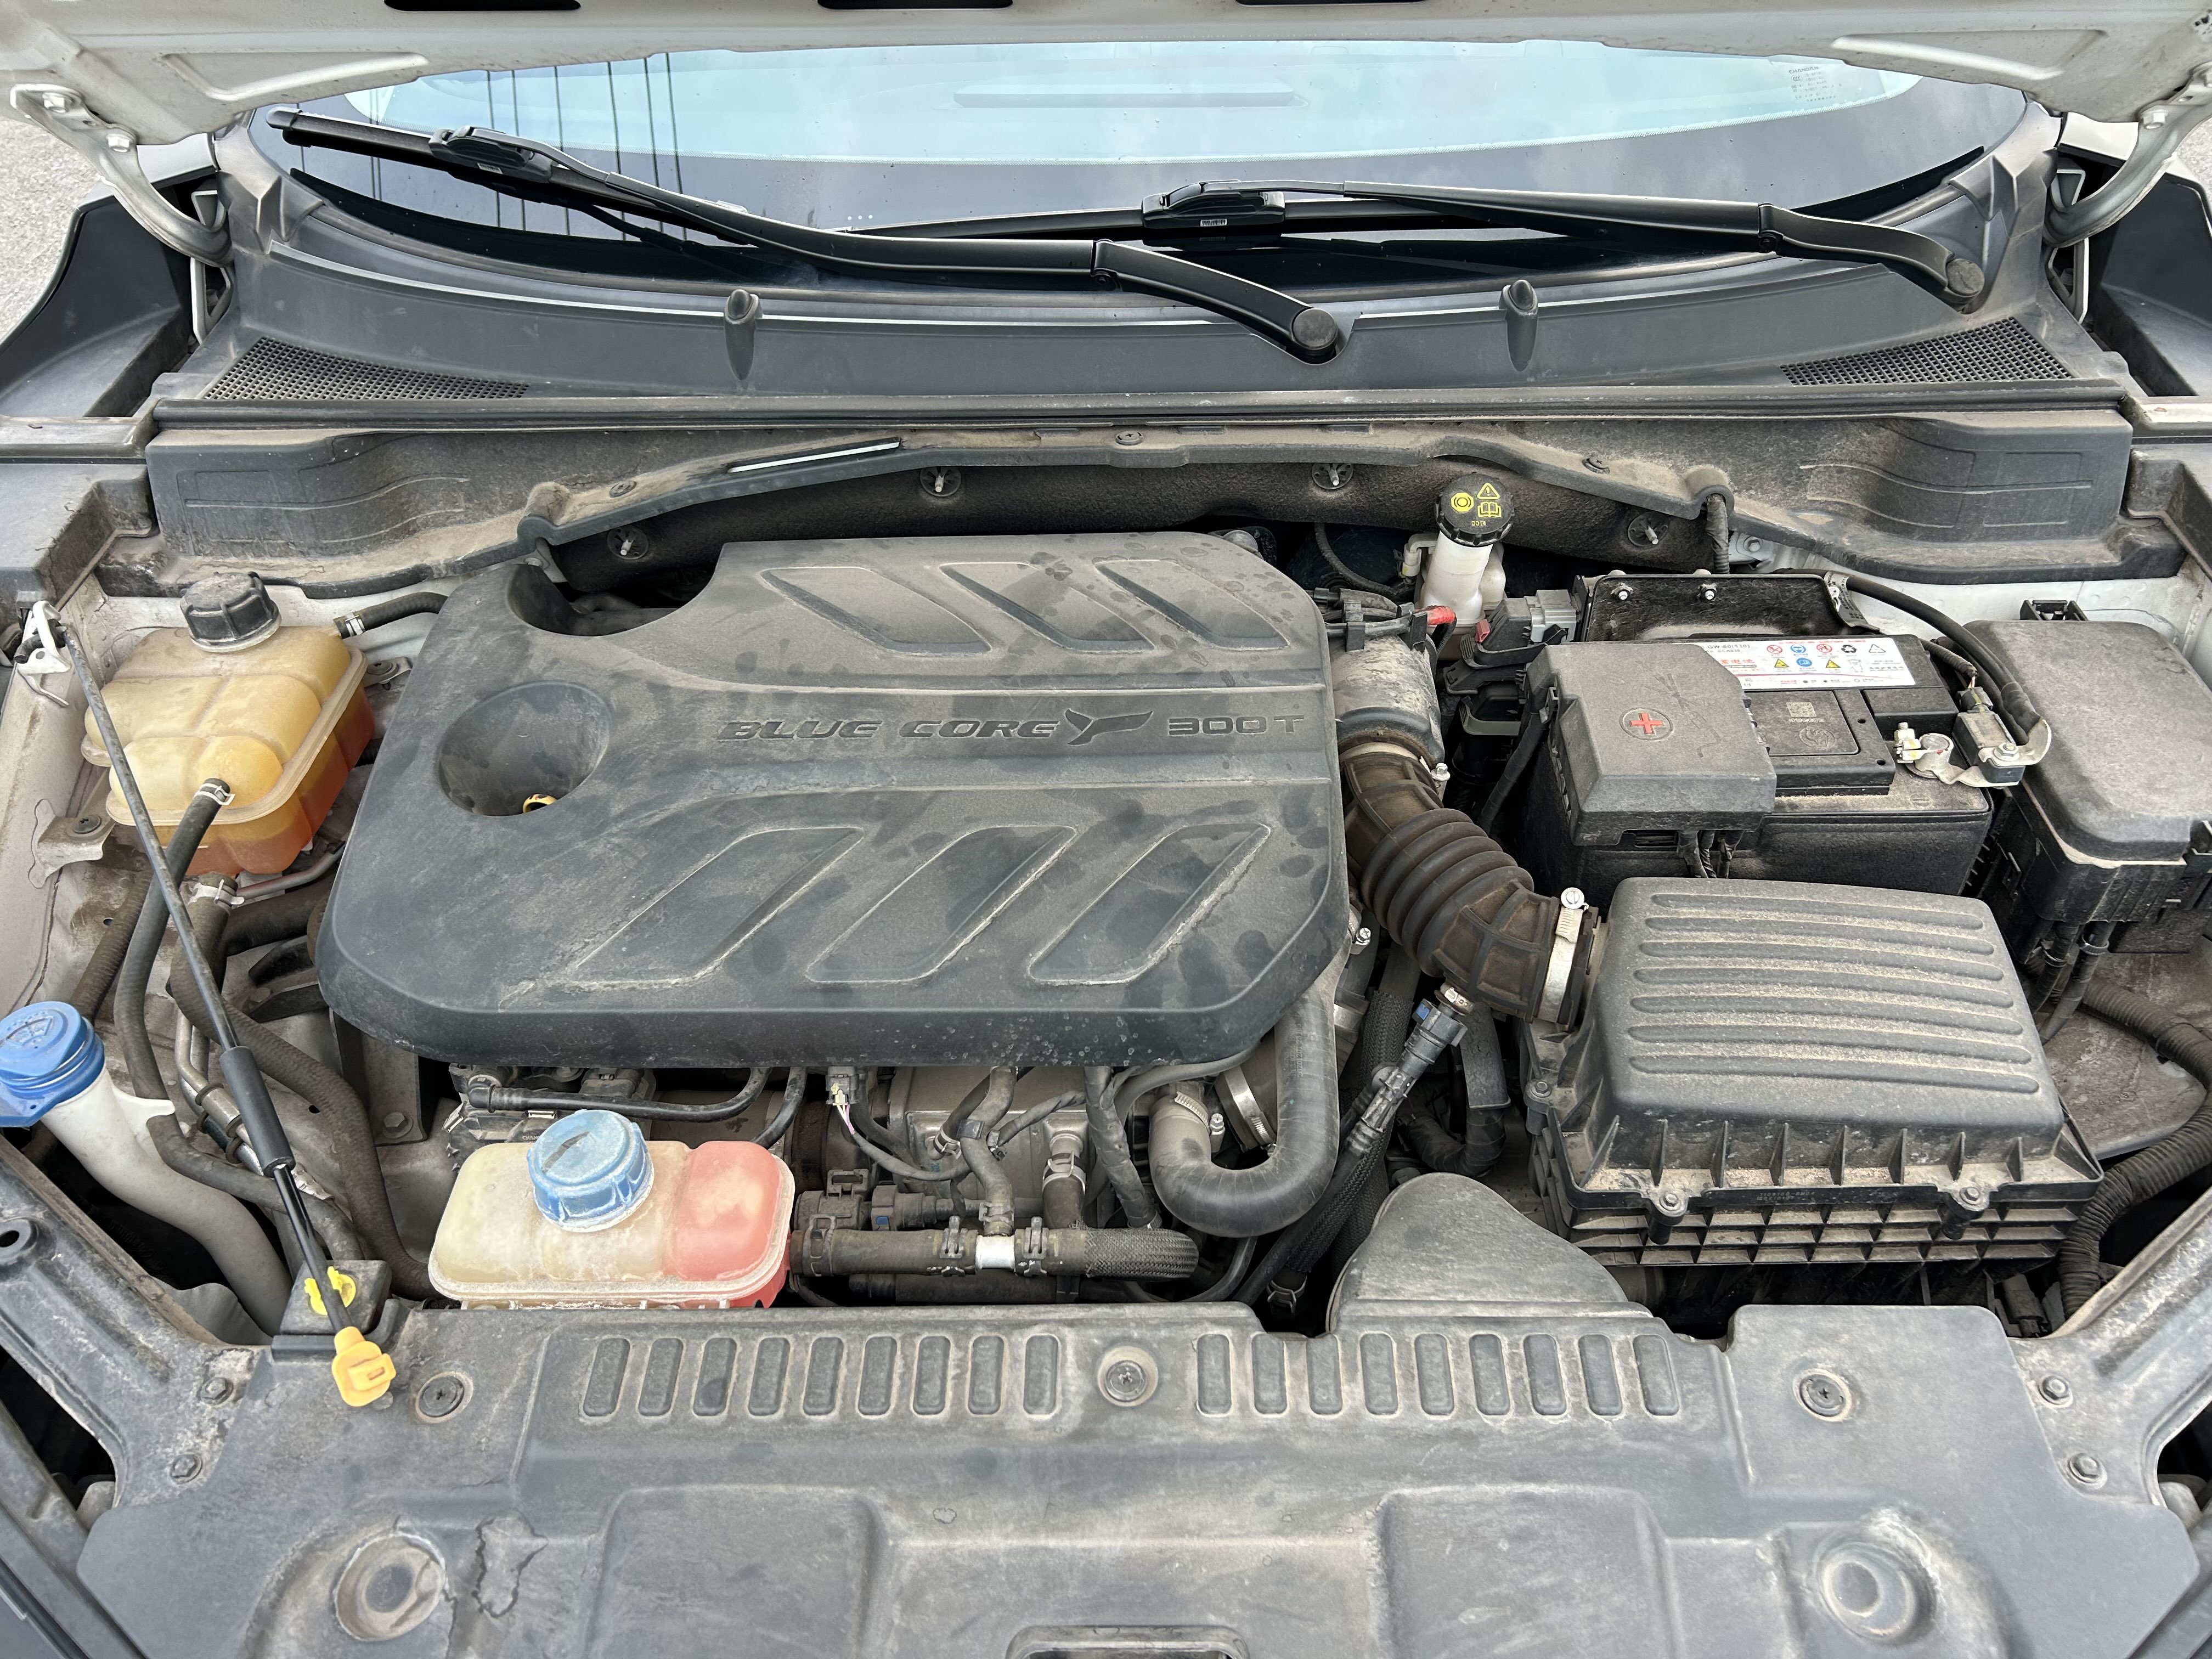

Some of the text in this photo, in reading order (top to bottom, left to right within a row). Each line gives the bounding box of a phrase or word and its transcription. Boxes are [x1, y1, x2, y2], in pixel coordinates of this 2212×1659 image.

[716, 715, 1304, 740] BLUE CORE 300T
